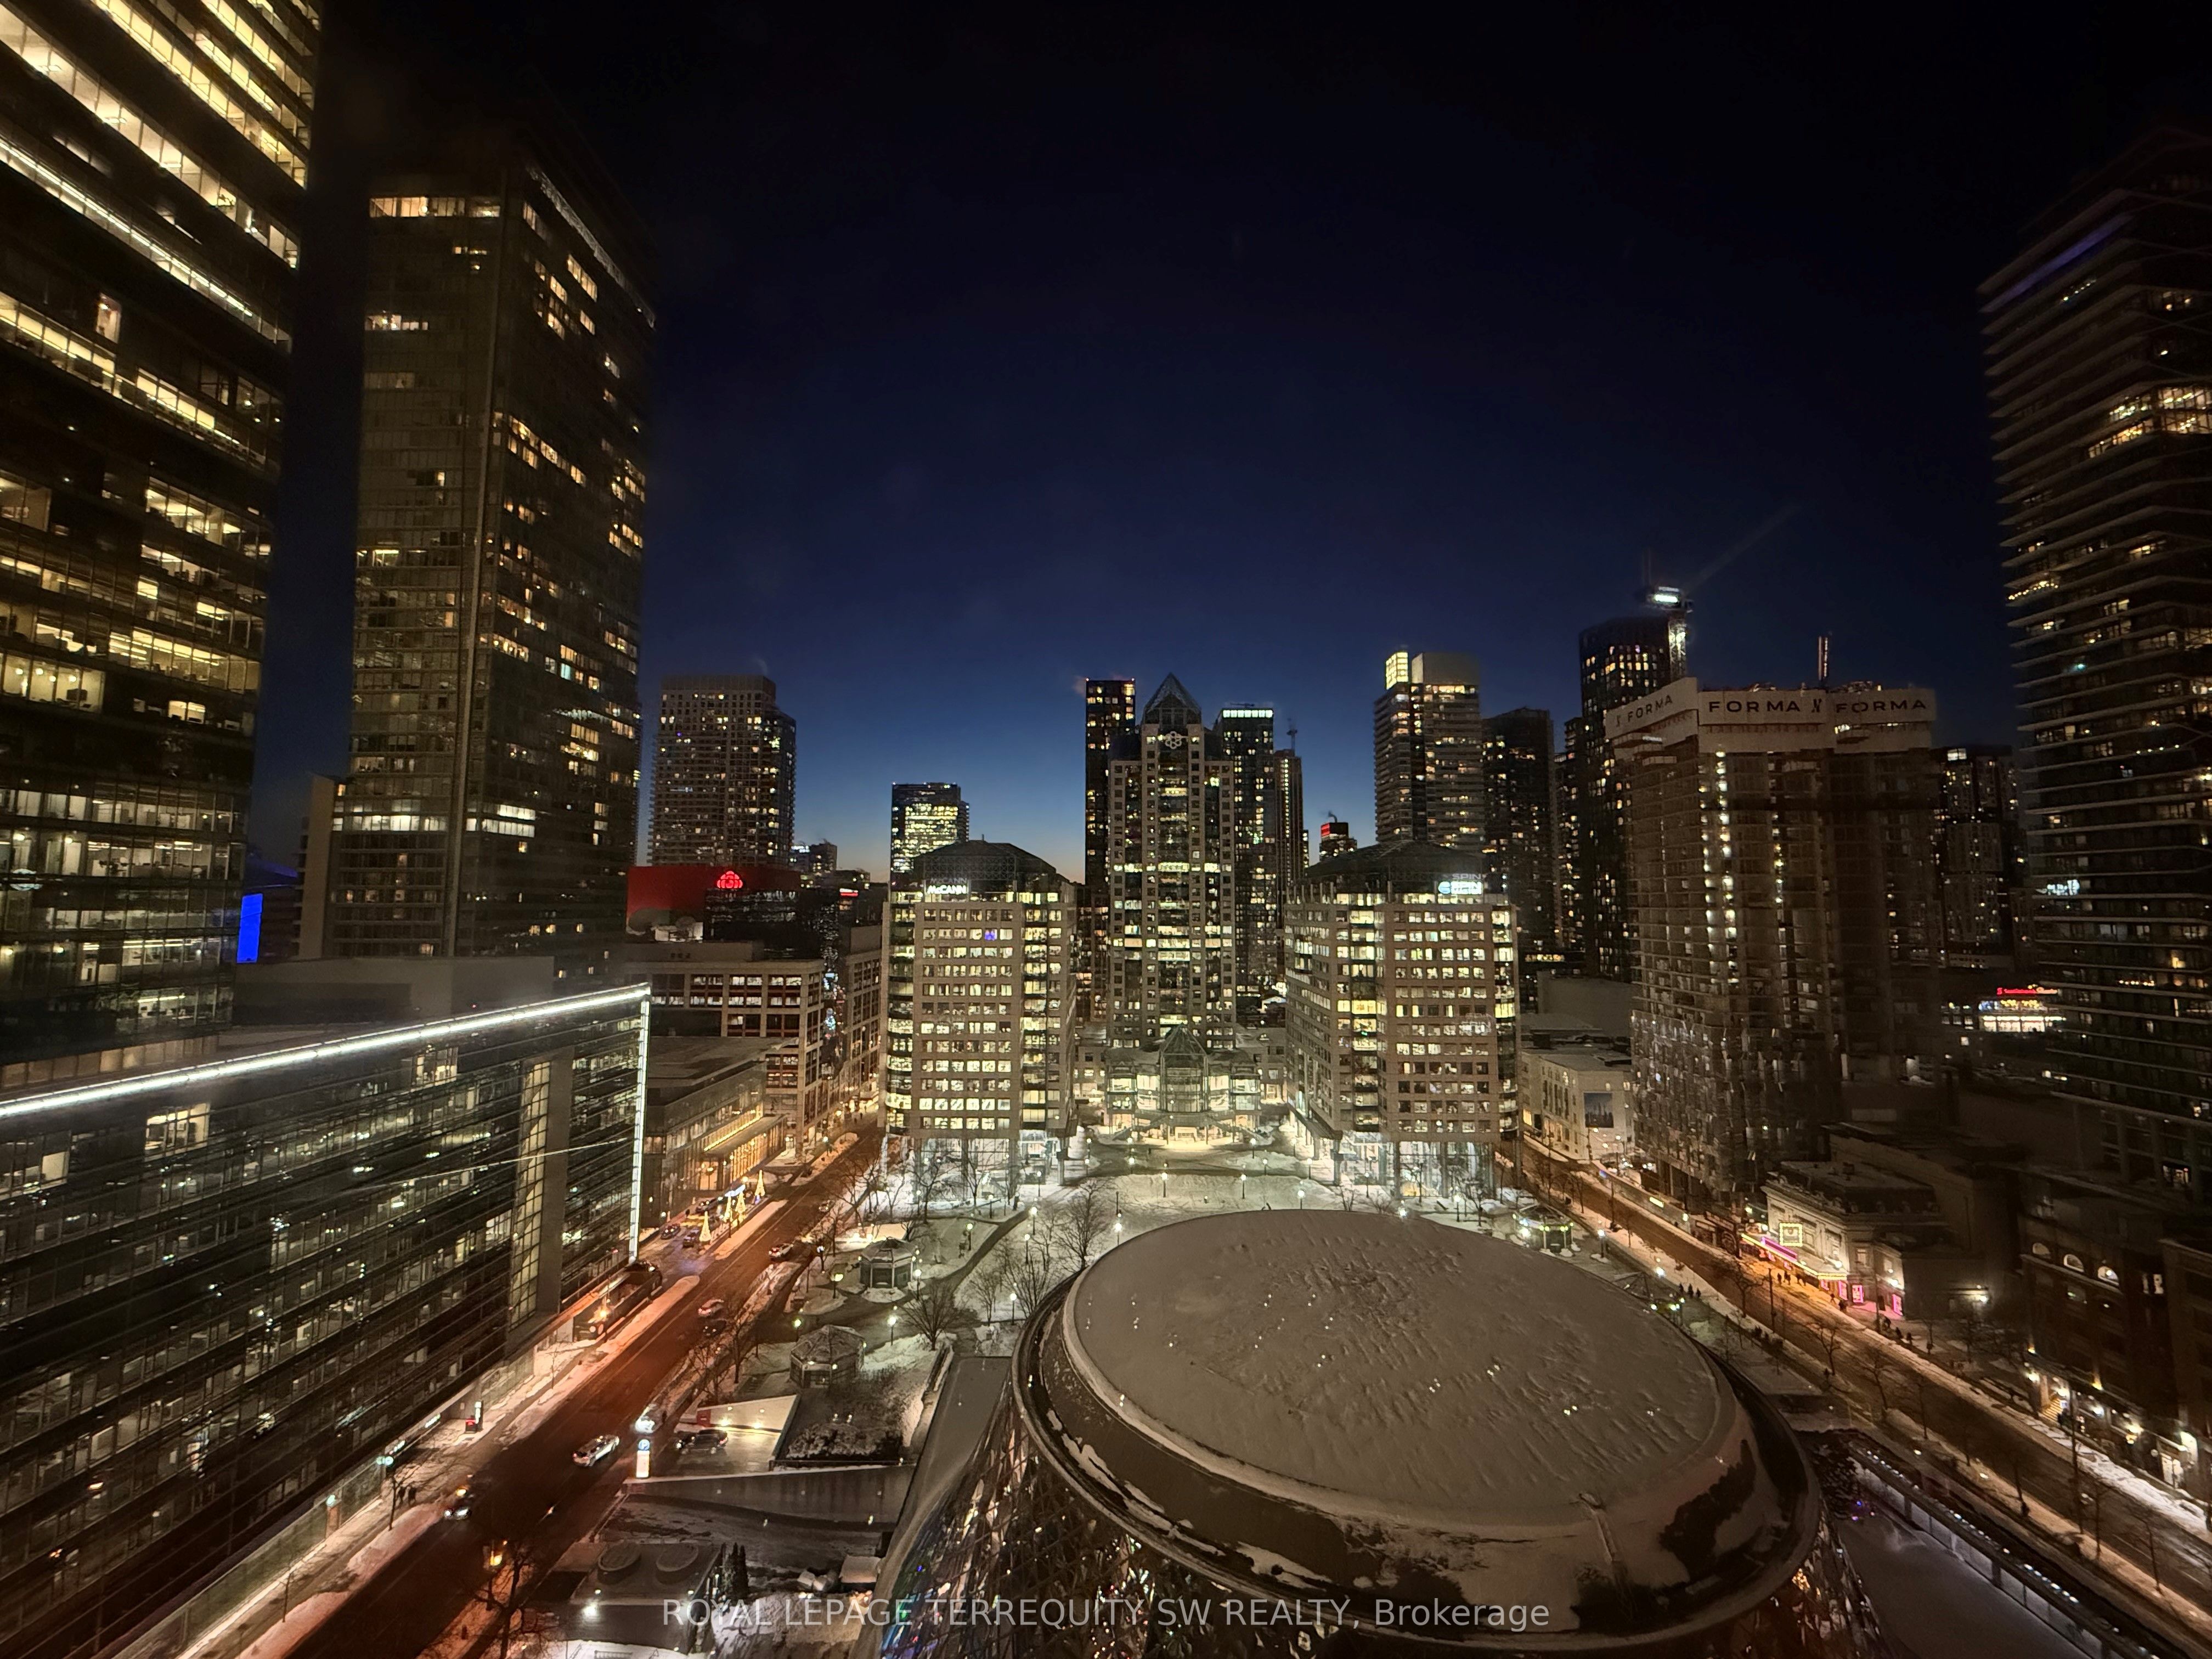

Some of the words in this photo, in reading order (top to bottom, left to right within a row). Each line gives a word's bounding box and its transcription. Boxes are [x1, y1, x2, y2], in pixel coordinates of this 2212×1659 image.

[1627, 695, 1673, 722] FORMA
[1709, 700, 1801, 713] FORMA
[1836, 699, 1927, 713] FORMA
[927, 884, 967, 895] McCANN
